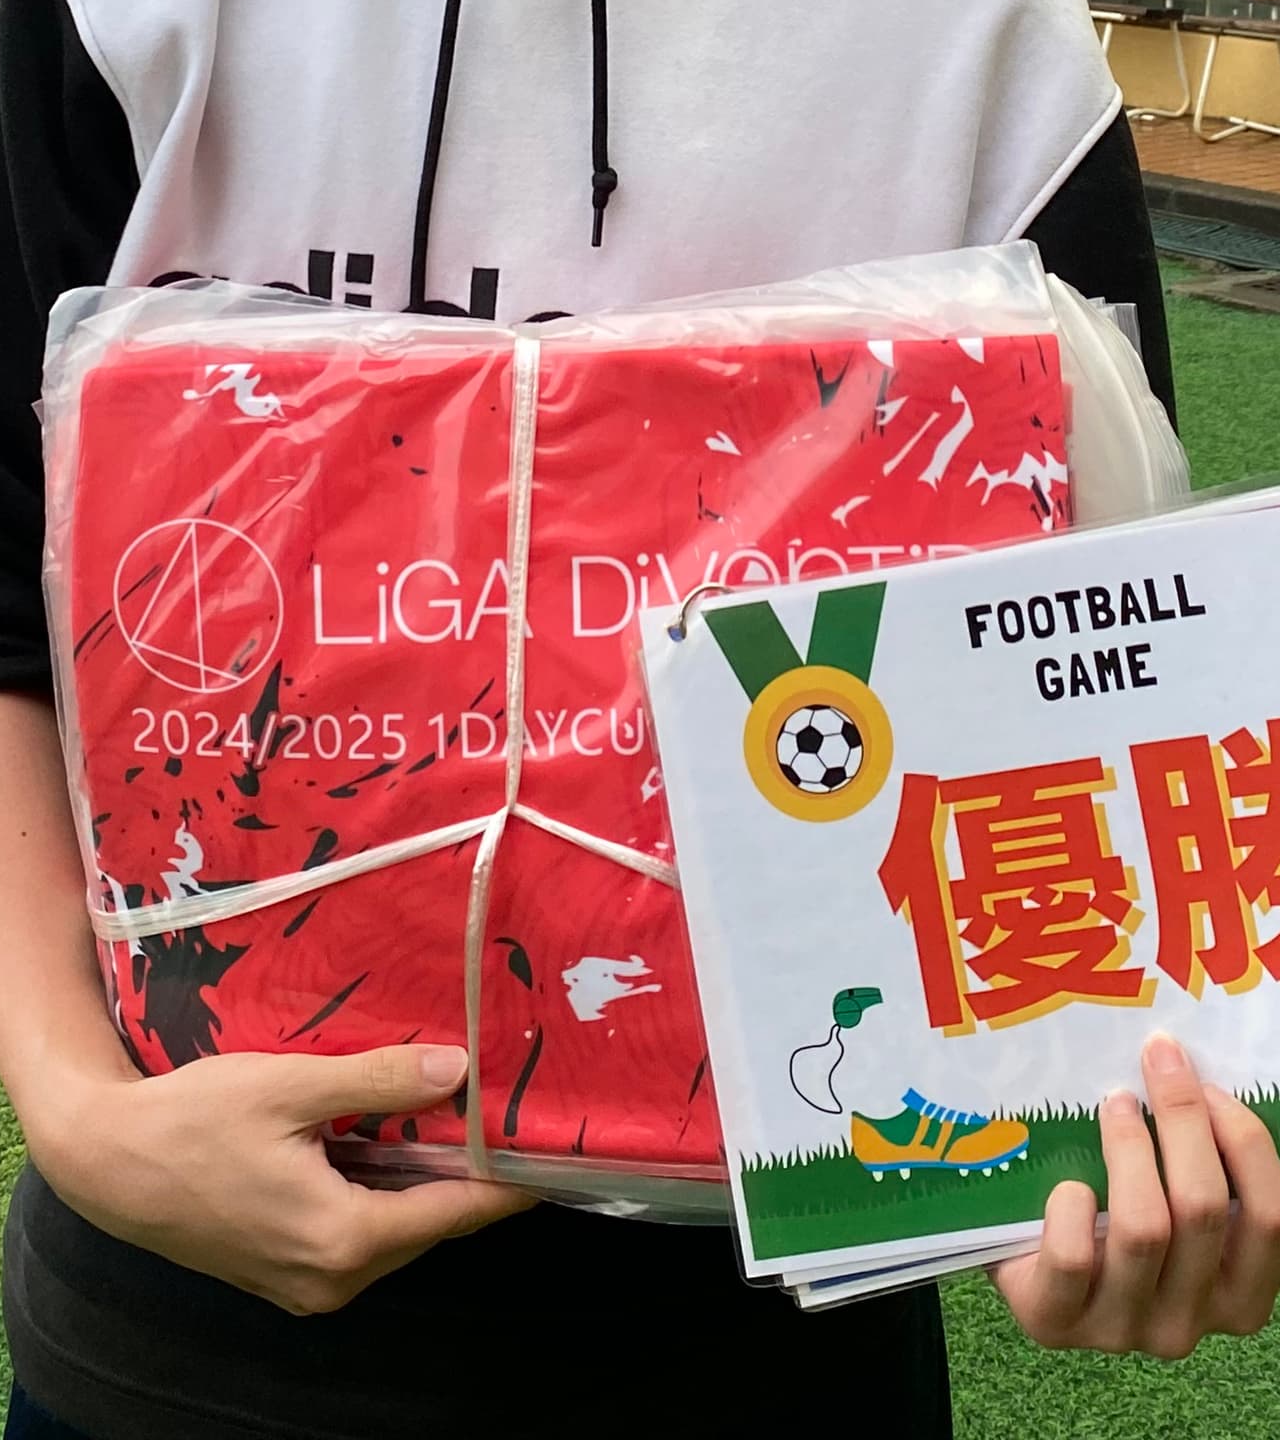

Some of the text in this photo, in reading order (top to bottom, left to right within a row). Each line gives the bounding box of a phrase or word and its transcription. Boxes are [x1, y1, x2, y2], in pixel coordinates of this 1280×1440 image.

[313, 557, 534, 645] LiGA
[964, 573, 1207, 649] FOOTBALL
[1035, 642, 1158, 702] GAME
[131, 707, 408, 767] 2024/2025
